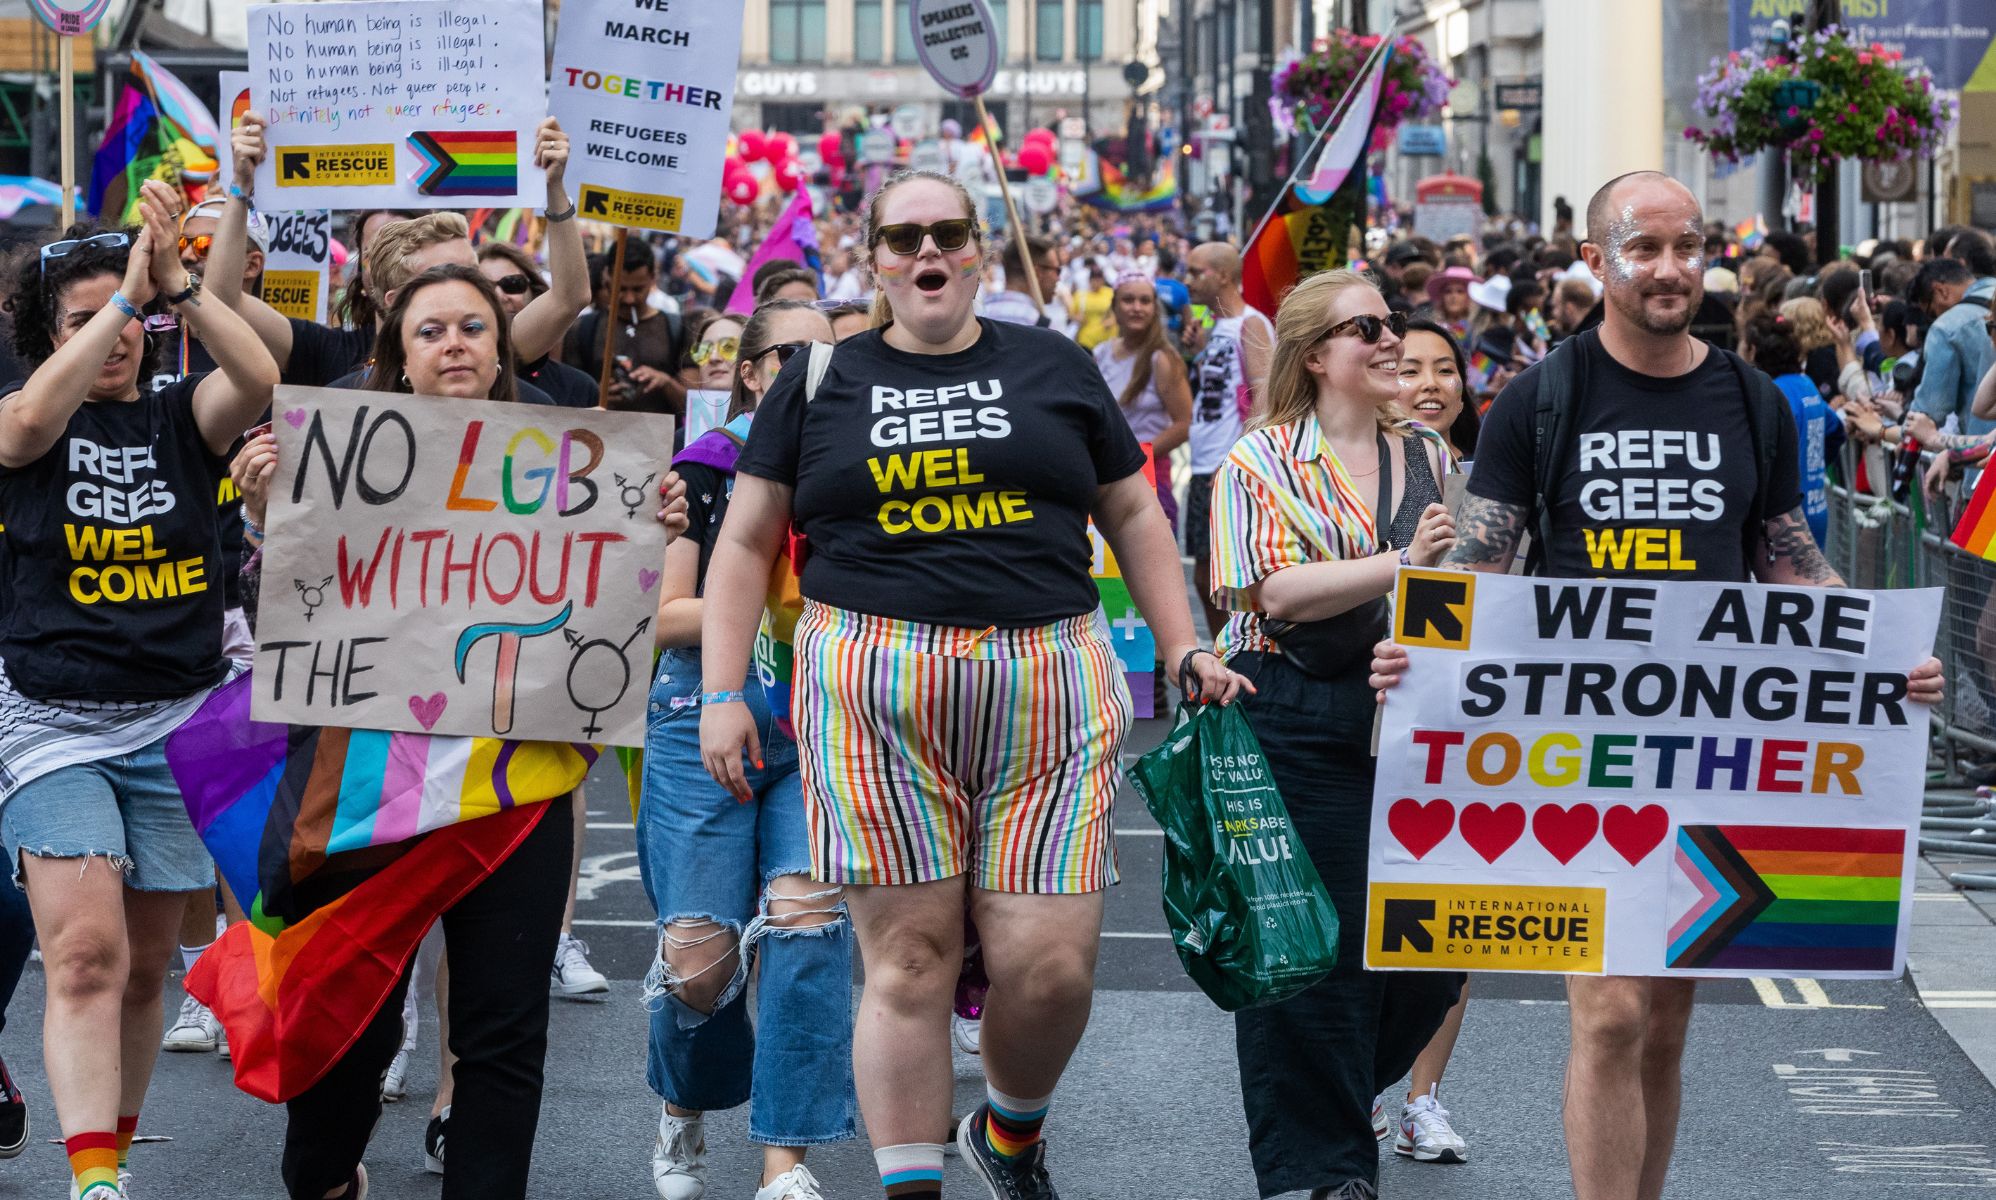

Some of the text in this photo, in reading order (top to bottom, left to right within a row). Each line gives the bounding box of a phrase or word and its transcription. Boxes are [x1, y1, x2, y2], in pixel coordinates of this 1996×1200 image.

[61, 13, 80, 25] PRIDE
[635, 0, 669, 12] WE
[921, 3, 975, 27] SPEAKERS
[267, 12, 294, 36] No
[305, 13, 357, 34] human
[367, 14, 400, 40] being
[410, 12, 422, 28] is
[604, 21, 690, 47] MARCH
[923, 21, 985, 47] COLLECTIVE
[268, 41, 294, 61] No
[306, 40, 357, 58] human
[367, 40, 402, 62] being
[410, 35, 422, 50] is
[269, 68, 294, 84] No
[306, 61, 359, 78] human
[369, 61, 402, 78] being
[411, 56, 422, 71] is
[743, 71, 816, 96] GUYS
[1015, 71, 1087, 94] GUYS
[269, 87, 298, 103] Not
[372, 82, 398, 97] Not
[406, 83, 438, 99] queer
[565, 67, 722, 111] TOGETHER
[270, 106, 341, 131] Definitely
[348, 104, 374, 120] not
[386, 102, 421, 119] queer
[590, 119, 687, 146] REFUGEES
[315, 150, 388, 158] INTERNATIONAL
[316, 157, 388, 171] RESCUE
[586, 142, 679, 169] WELCOME
[315, 170, 389, 179] COMMITTEE
[613, 201, 676, 220] RESCUE
[264, 214, 328, 263] UGEES
[263, 287, 310, 304] ESCUE
[872, 379, 1003, 413] REFU
[870, 406, 1012, 448] GEES
[292, 405, 605, 518] NO LGB
[1580, 430, 1721, 472] REFU
[866, 448, 984, 494] WEL
[67, 480, 176, 524] GEES
[877, 491, 1034, 535] COME
[1579, 478, 1726, 521] GEES
[64, 523, 167, 561] WEL
[1582, 528, 1697, 571] WEL
[69, 556, 208, 605] COME
[337, 526, 630, 609] WITHOUT
[1533, 584, 1872, 656] WE ARE
[260, 600, 573, 734] THE T
[1460, 662, 1911, 727] STRONGER
[1224, 756, 1235, 768] IS
[1412, 729, 1866, 796] TOGETHER
[1226, 798, 1263, 813] HIS IS
[1228, 835, 1293, 865] ALUE
[1448, 899, 1591, 914] INTERNATIONAL
[1447, 914, 1590, 944] RESCUE
[1445, 944, 1590, 958] COMMITTEE
